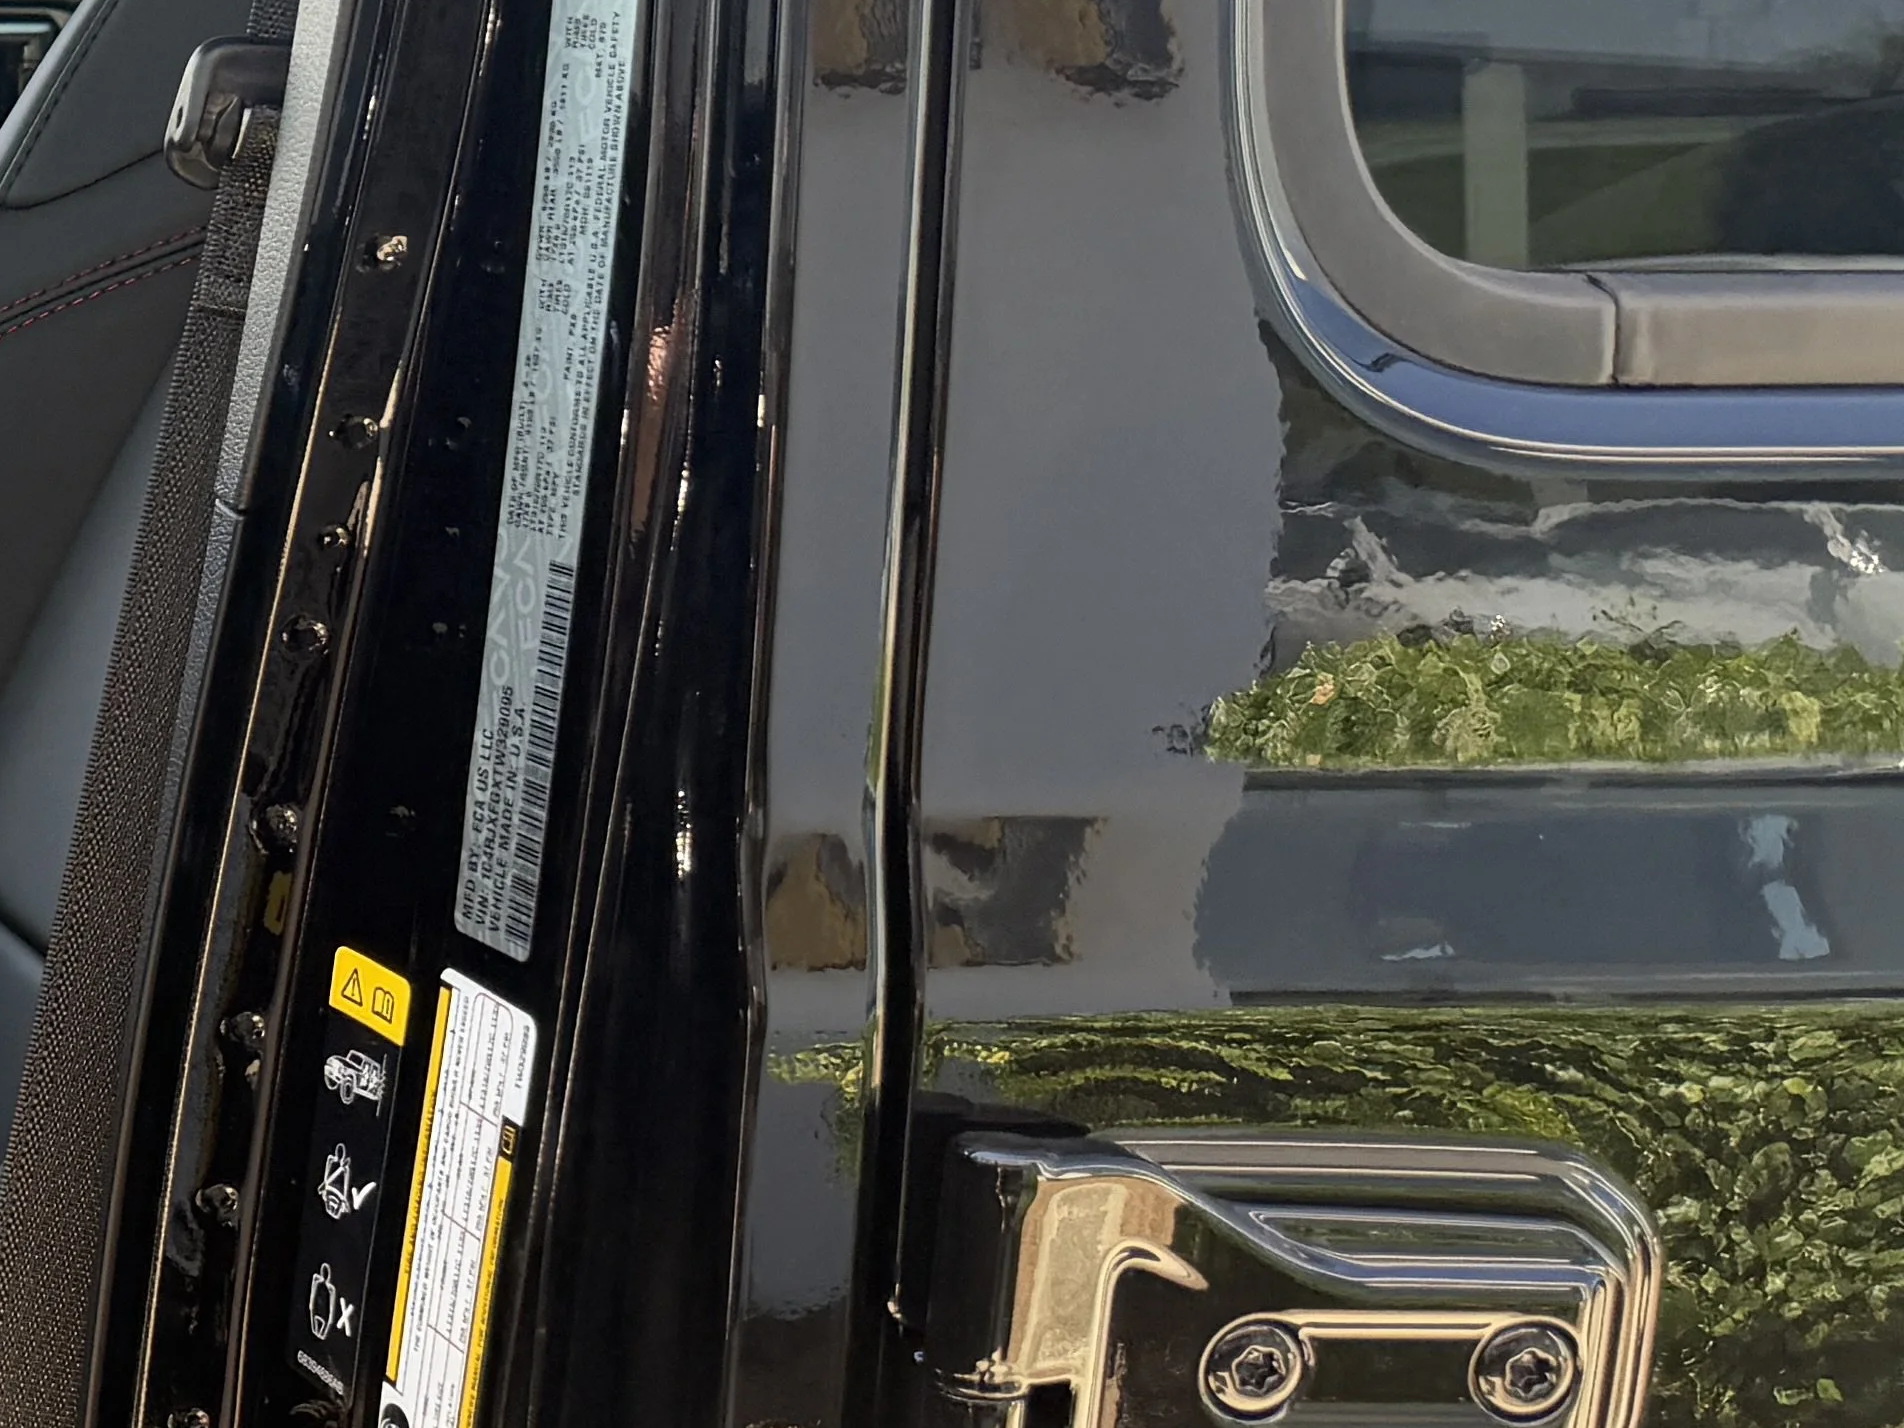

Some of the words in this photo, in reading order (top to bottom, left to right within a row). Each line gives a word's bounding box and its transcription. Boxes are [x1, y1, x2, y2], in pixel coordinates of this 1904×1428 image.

[602, 62, 616, 113] VEHICLE
[598, 116, 611, 161] MOTOR
[591, 164, 606, 221] FEDERAL
[598, 154, 617, 248] MANUFACTURE
[479, 726, 493, 762] LLC
[475, 764, 489, 794] US
[471, 796, 485, 835] FCA
[497, 794, 514, 852] MADE
[462, 877, 476, 921] MFD
[475, 885, 490, 929] VIN:
[488, 856, 507, 935] VEHICLE
